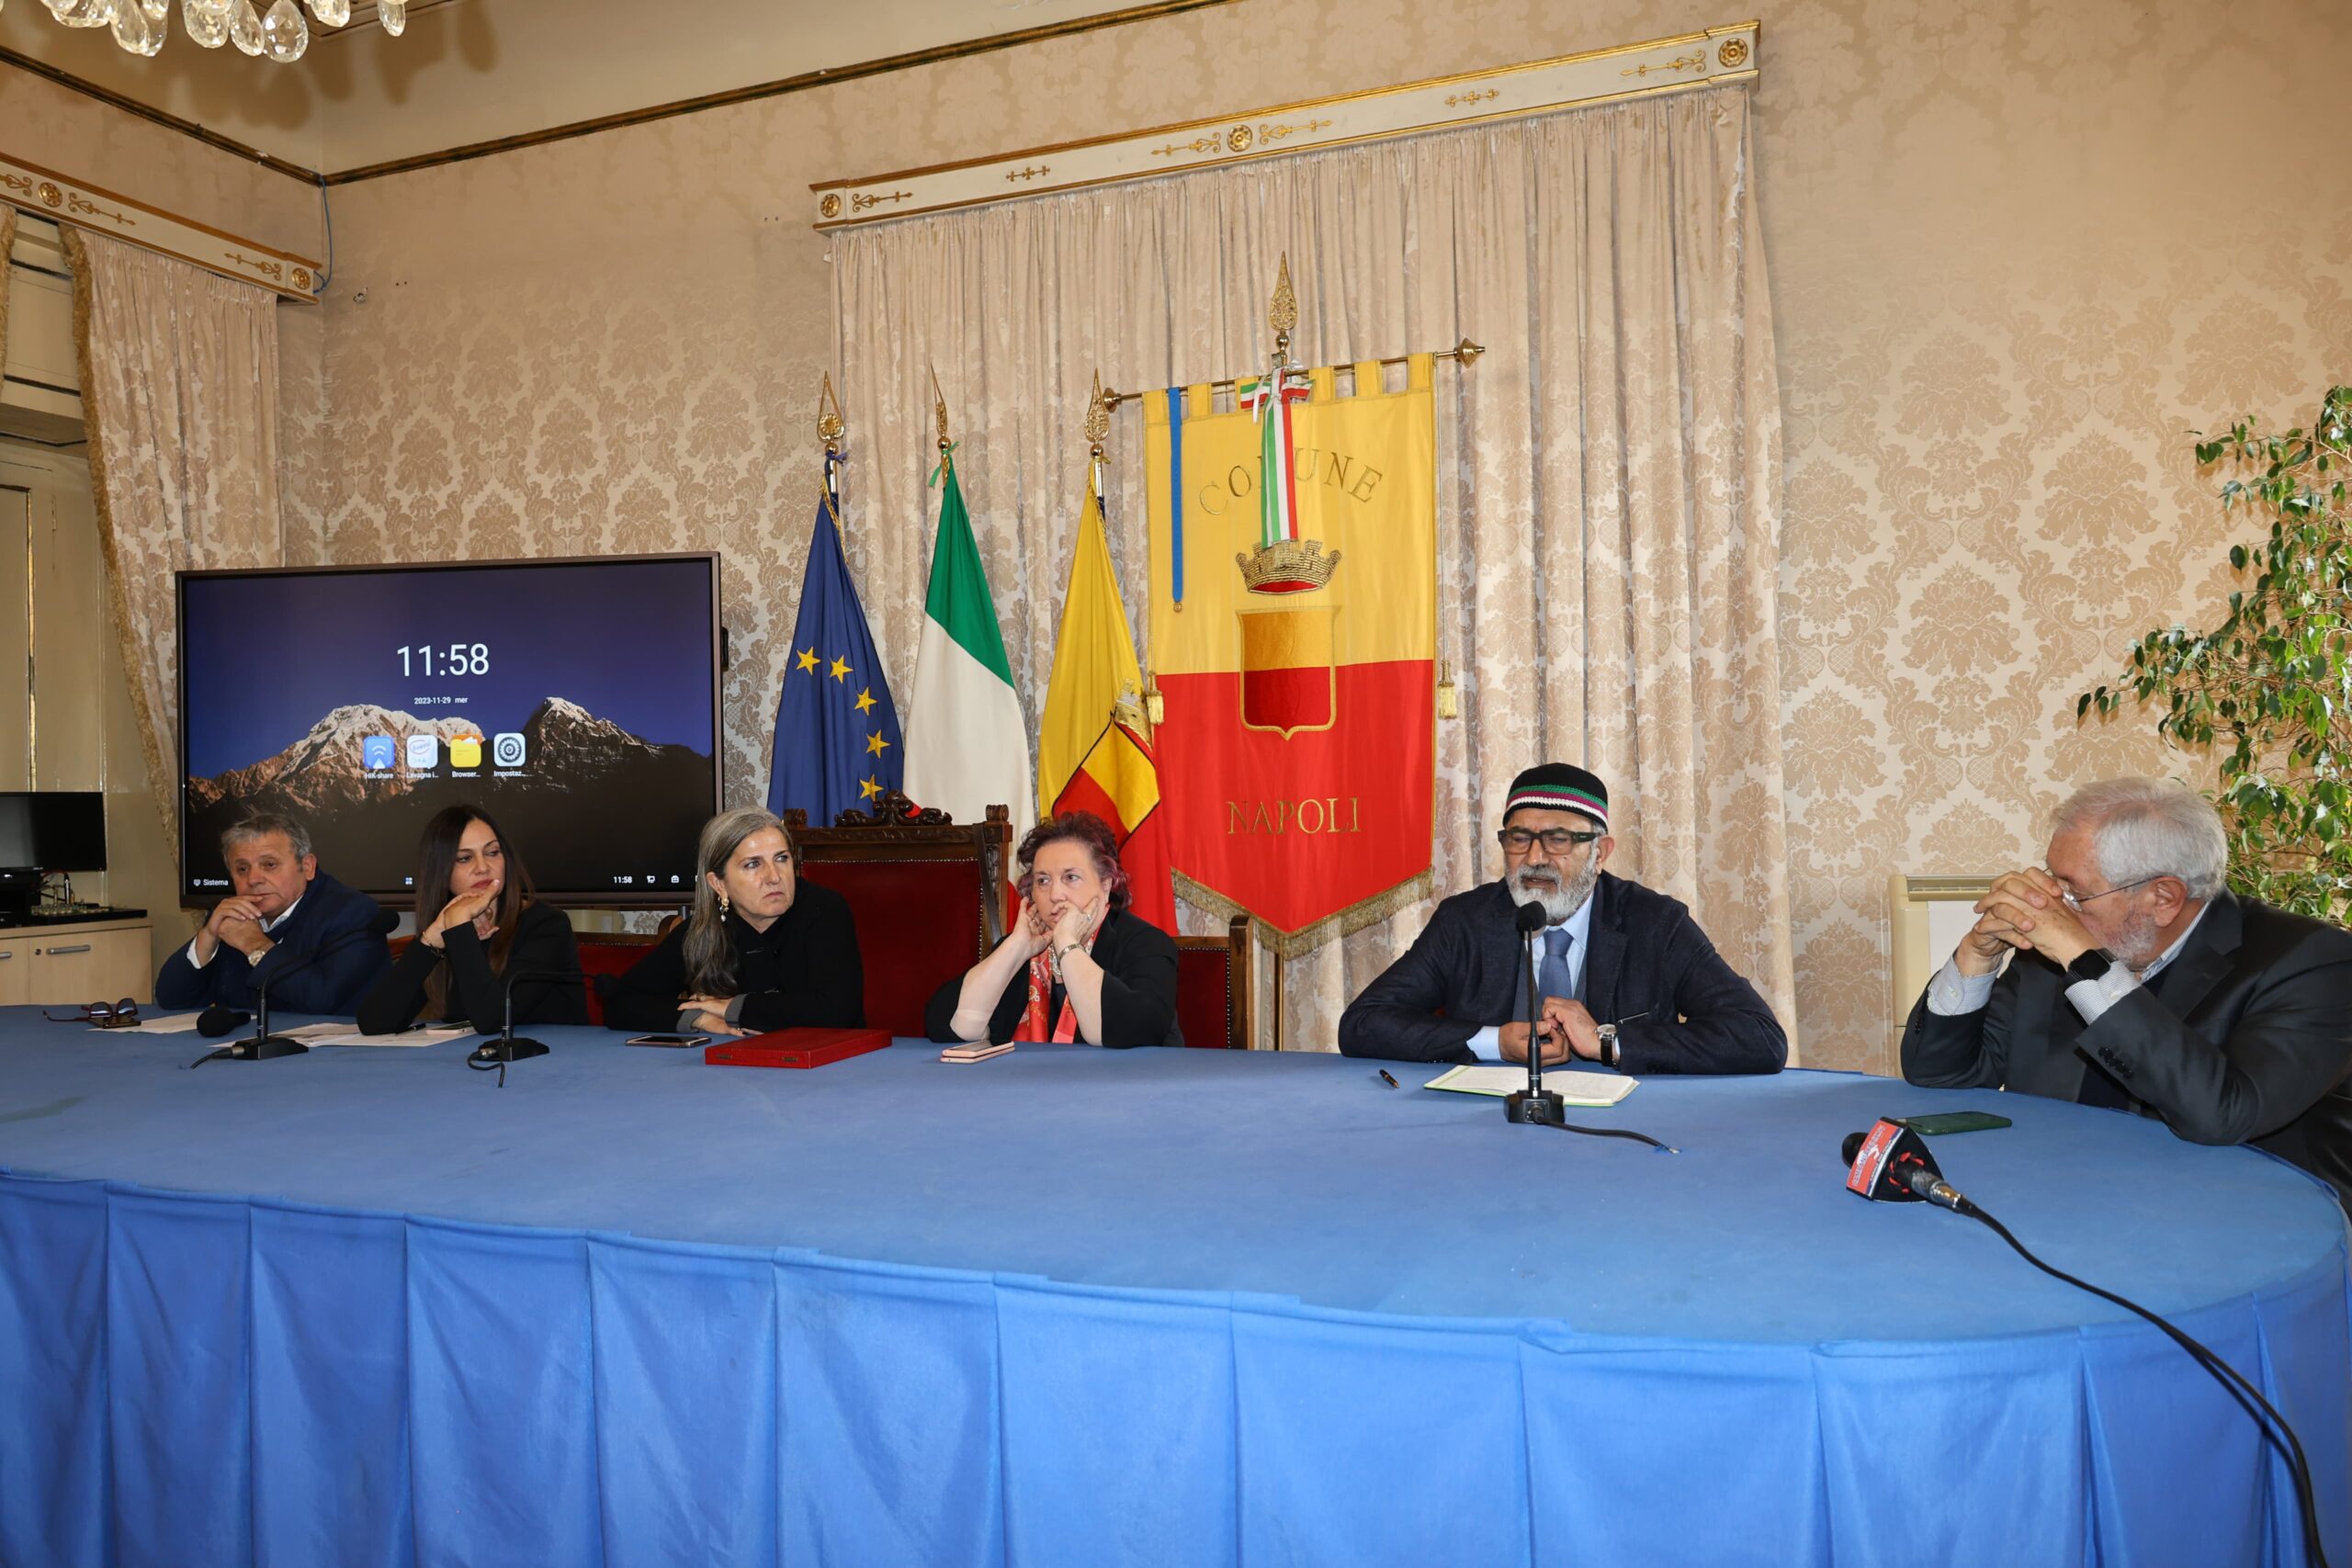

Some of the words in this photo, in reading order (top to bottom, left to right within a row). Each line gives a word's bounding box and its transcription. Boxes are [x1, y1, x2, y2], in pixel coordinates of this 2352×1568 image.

[397, 643, 490, 677] 11:58
[413, 696, 451, 705] 2023-11-29
[406, 772, 431, 780] Lavagna
[1226, 797, 1361, 834] NAPOLI
[613, 875, 633, 884] 11:58
